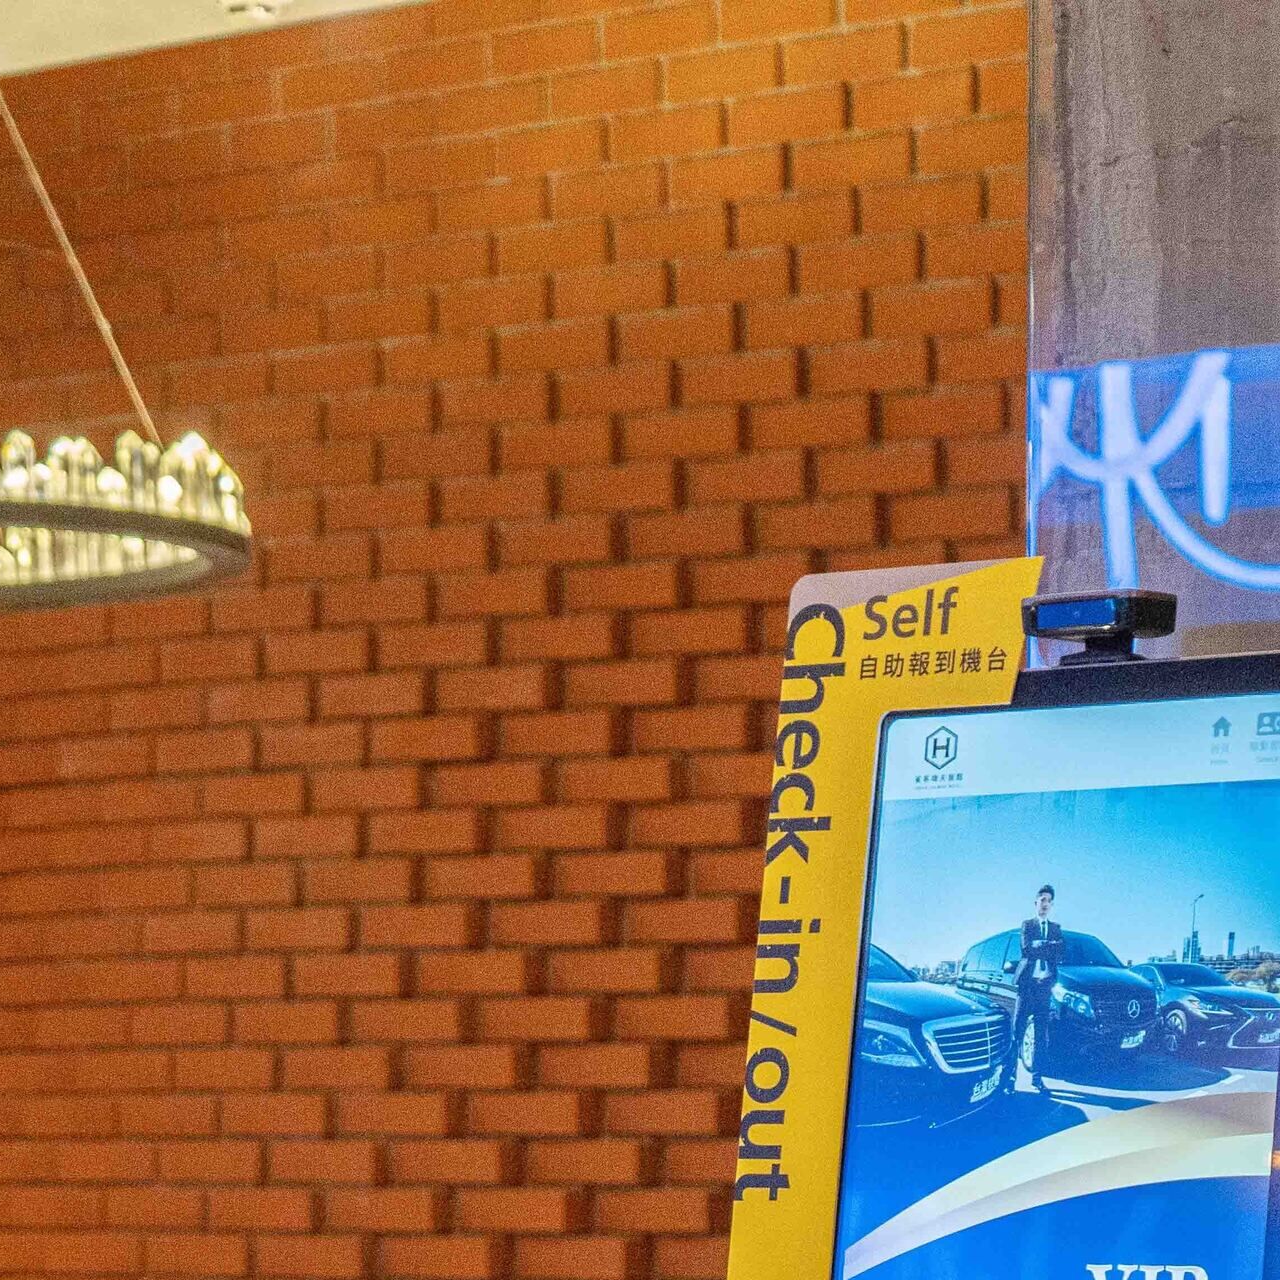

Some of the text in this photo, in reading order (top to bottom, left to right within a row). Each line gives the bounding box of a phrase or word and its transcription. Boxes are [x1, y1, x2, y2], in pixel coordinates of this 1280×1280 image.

[863, 586, 959, 641] Self
[859, 646, 1008, 681] 自助報到機台
[734, 603, 846, 1201] Check-in/out
